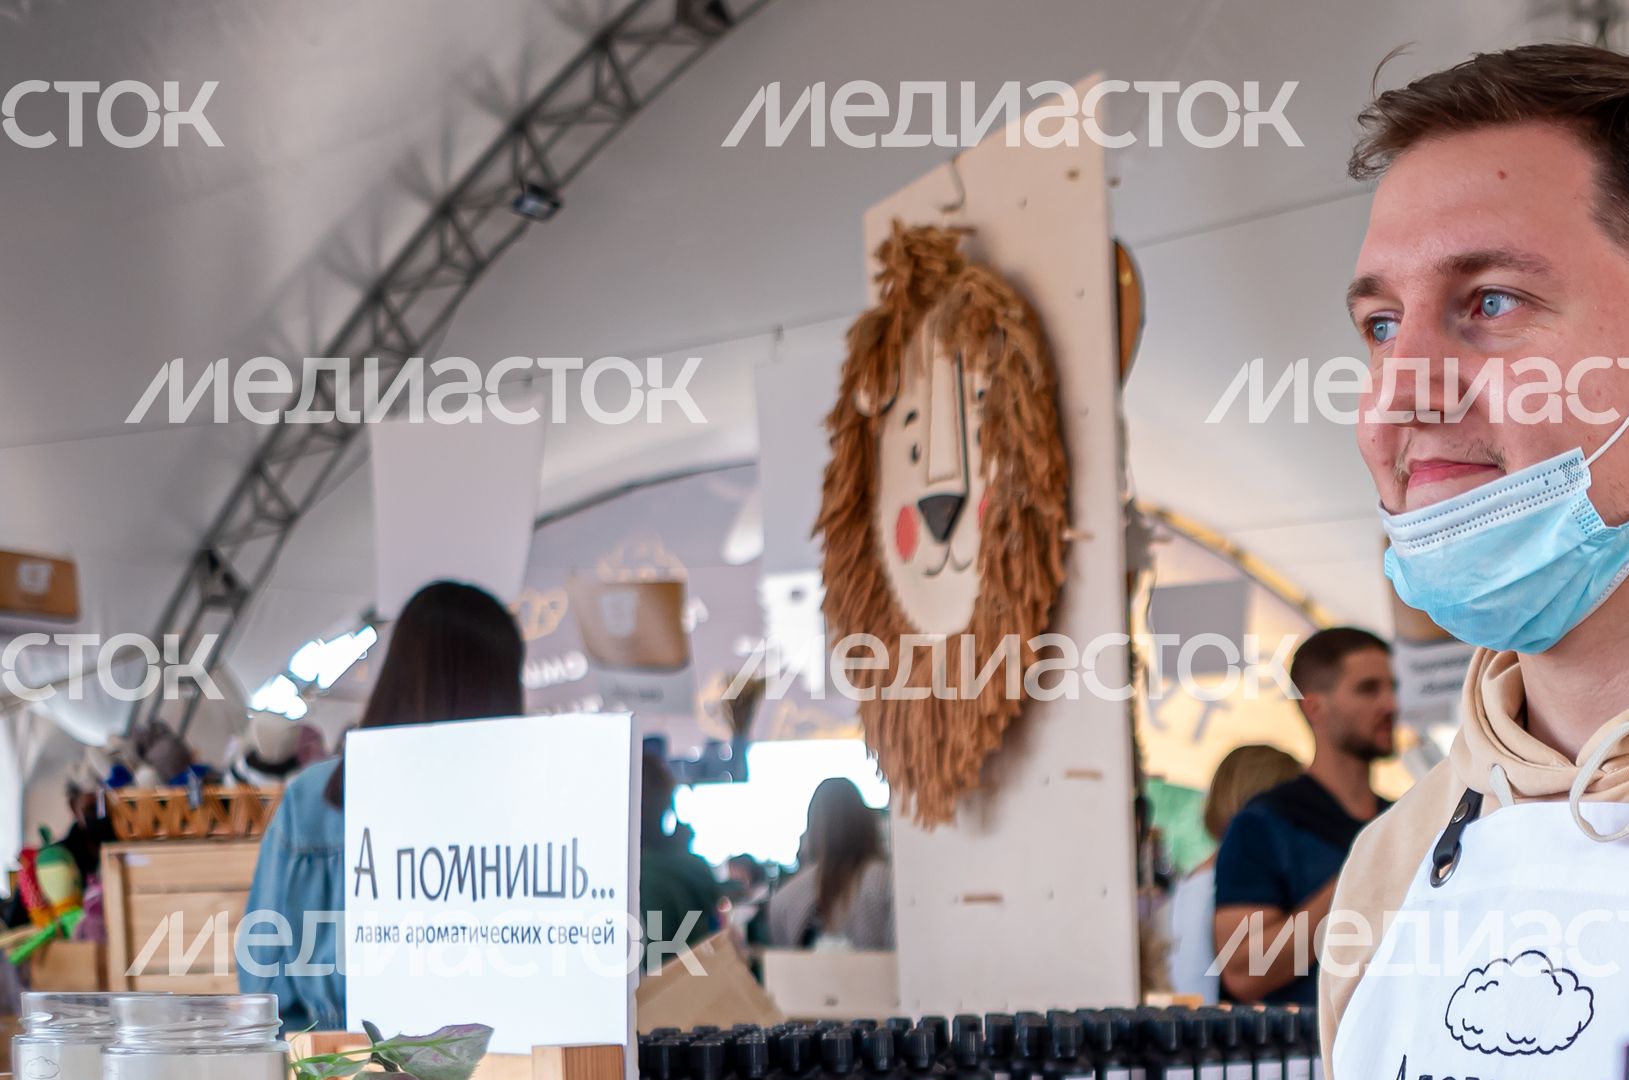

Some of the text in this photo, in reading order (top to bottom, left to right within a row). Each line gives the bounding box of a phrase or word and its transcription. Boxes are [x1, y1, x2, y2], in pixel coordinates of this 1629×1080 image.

[354, 827, 378, 900] А
[355, 918, 616, 949] лавка ароматических свечей
